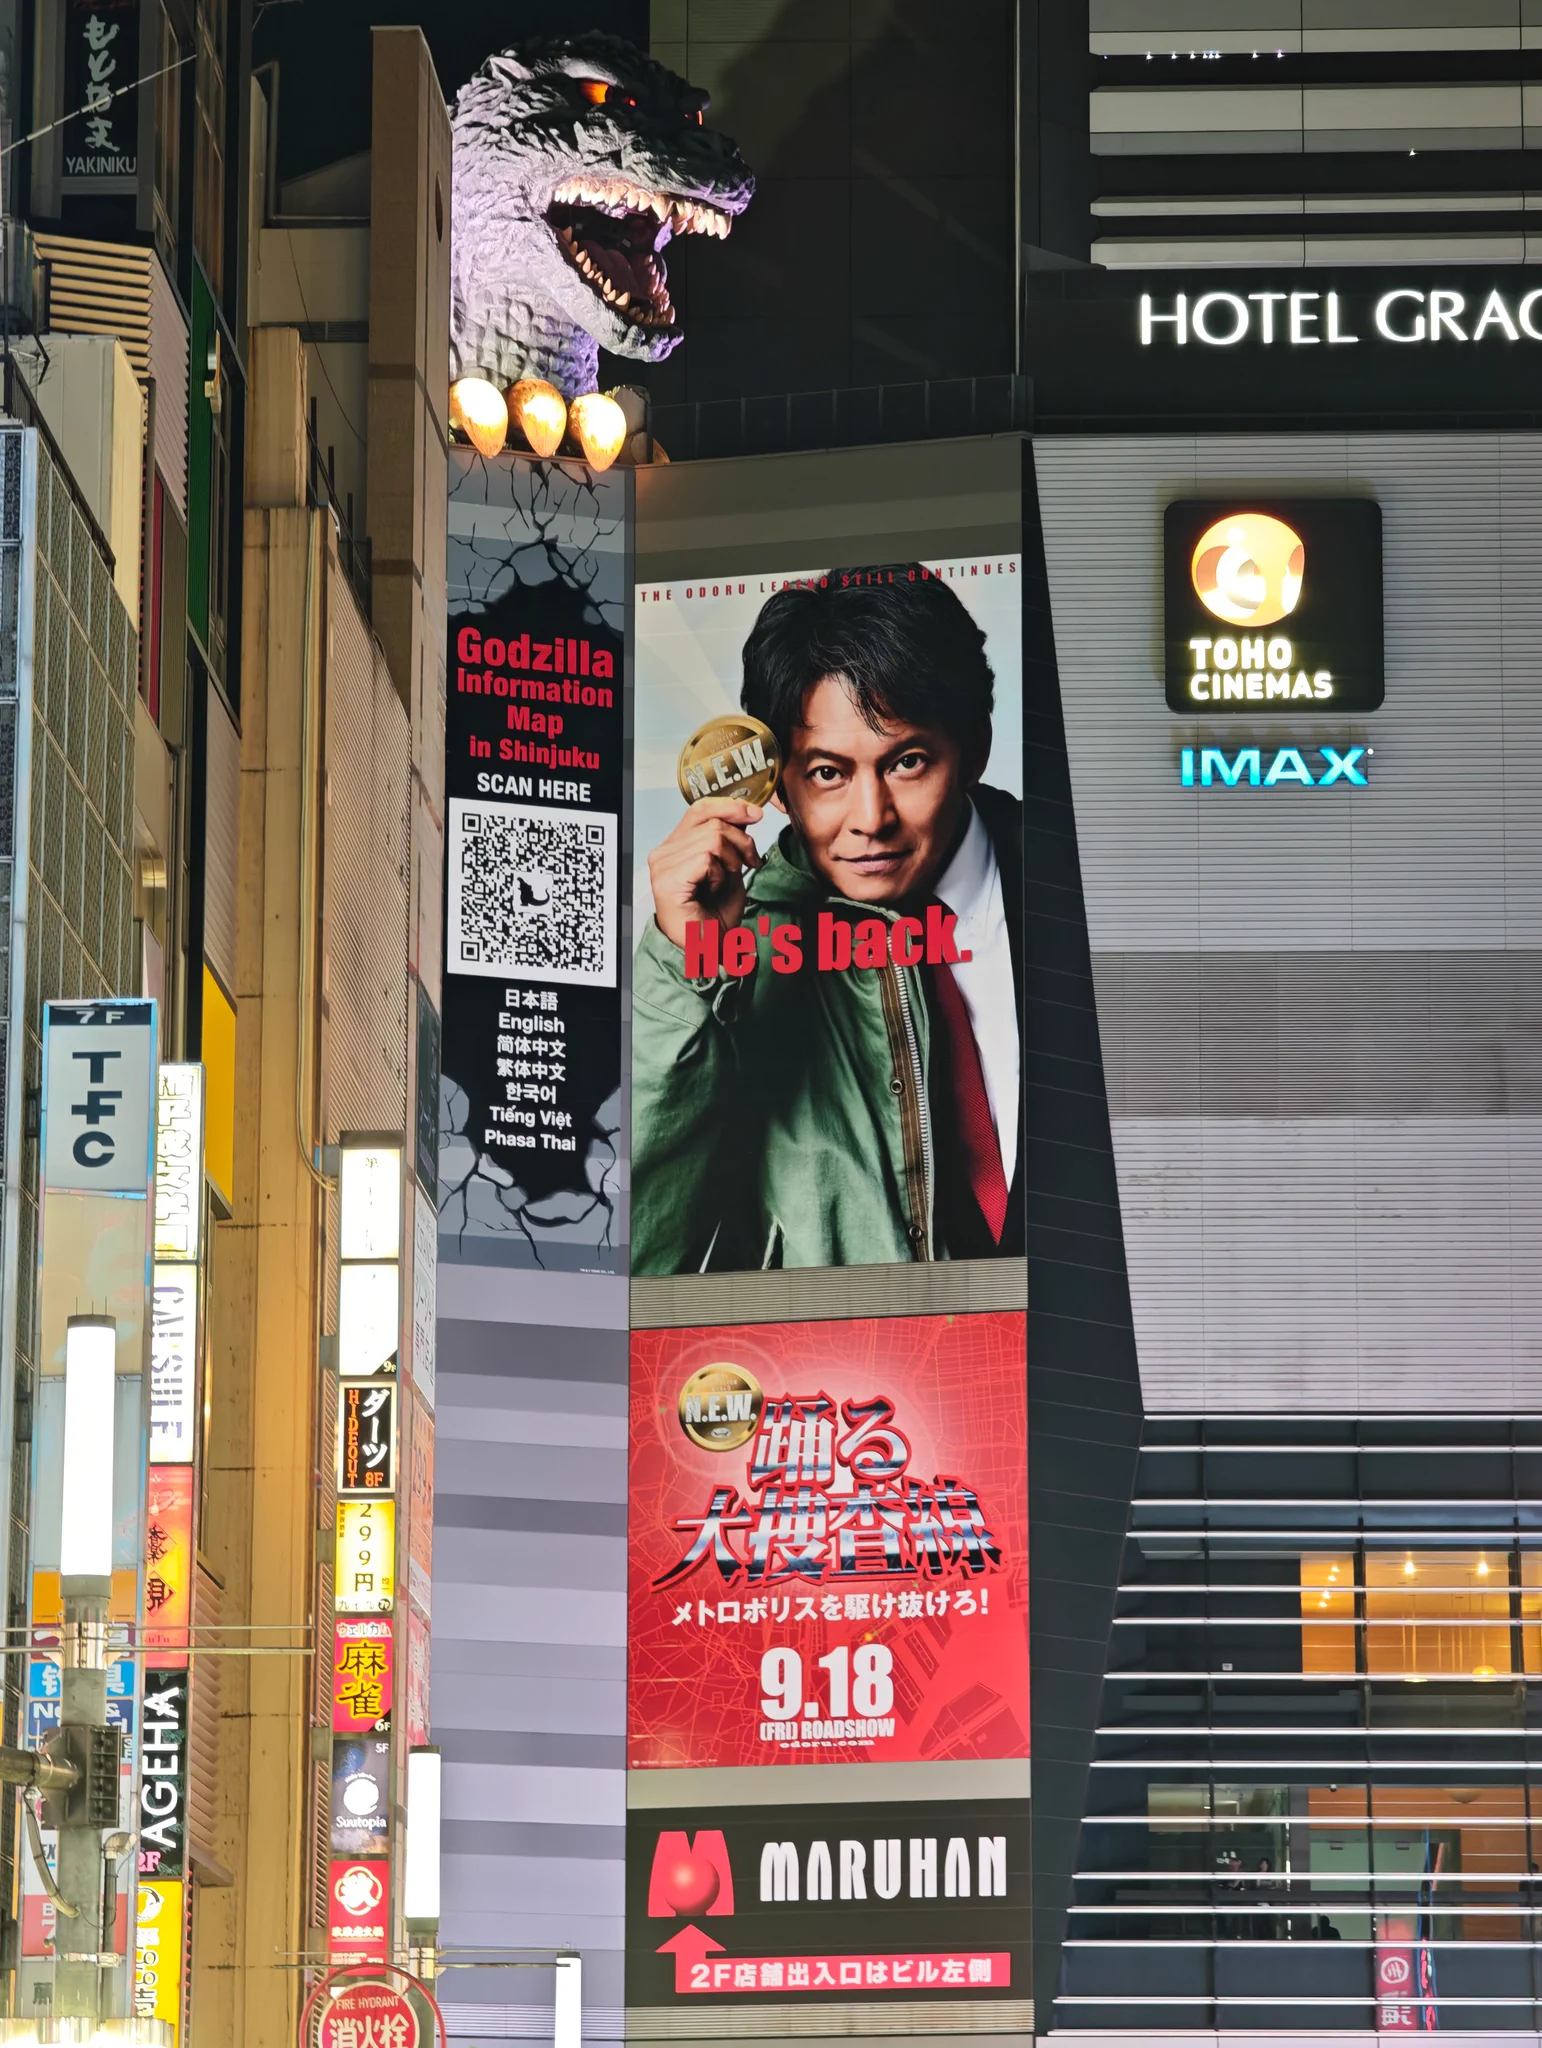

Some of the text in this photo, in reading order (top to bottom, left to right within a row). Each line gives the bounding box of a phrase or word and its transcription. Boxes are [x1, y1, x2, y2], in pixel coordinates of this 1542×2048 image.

[66, 156, 137, 174] YAKINIKU
[1140, 291, 1359, 345] HOTEL
[641, 590, 672, 602] THE
[686, 583, 745, 599] ODORU
[842, 572, 894, 588] STILL
[907, 562, 1016, 582] CONTINUES
[457, 626, 613, 679] Godzilla
[1189, 637, 1293, 670] TOHO
[457, 667, 613, 708] Information
[1189, 670, 1333, 700] CINEMAS
[507, 705, 564, 739] Map
[469, 735, 600, 770] in Shinjuku
[1181, 746, 1369, 787] IMAX
[684, 738, 775, 800] N.E.W.
[476, 772, 592, 803] SCAN HERE
[684, 904, 973, 980] He's back.
[505, 988, 559, 1011] 日本語
[498, 1012, 566, 1034] English
[496, 1034, 567, 1059] 简体中文
[496, 1057, 567, 1082] 繁体中文
[505, 1082, 557, 1105] 한국어
[489, 1105, 573, 1131] Tiếng Việt
[484, 1129, 577, 1152] Phasa Thai
[685, 1393, 757, 1423] N.E.W.
[347, 1389, 360, 1488] HIDEOUT
[361, 1388, 391, 1469] ダーツ
[750, 1392, 910, 1487] 踊る
[365, 1472, 384, 1488] 8F
[671, 1588, 989, 1627] メトロポリスを駆け抜けろ!
[336, 1622, 392, 1638] ウェルカム
[337, 1640, 388, 1718] 麻雀
[760, 1643, 894, 1720] 9.18
[374, 1718, 391, 1732] 6F
[759, 1718, 896, 1741] (FRI) ROADSHOW
[375, 1742, 390, 1754] 5F
[779, 1739, 875, 1749] odoru.com
[140, 1686, 180, 1849] AGEHA
[336, 1815, 387, 1831] Suutopia
[760, 1836, 1006, 1902] MARUHAN
[690, 1957, 992, 1989] 2F店舗出入口はビル左側
[336, 1996, 400, 2010] FIRE HYDRANT
[328, 2013, 410, 2048] 消火栓
